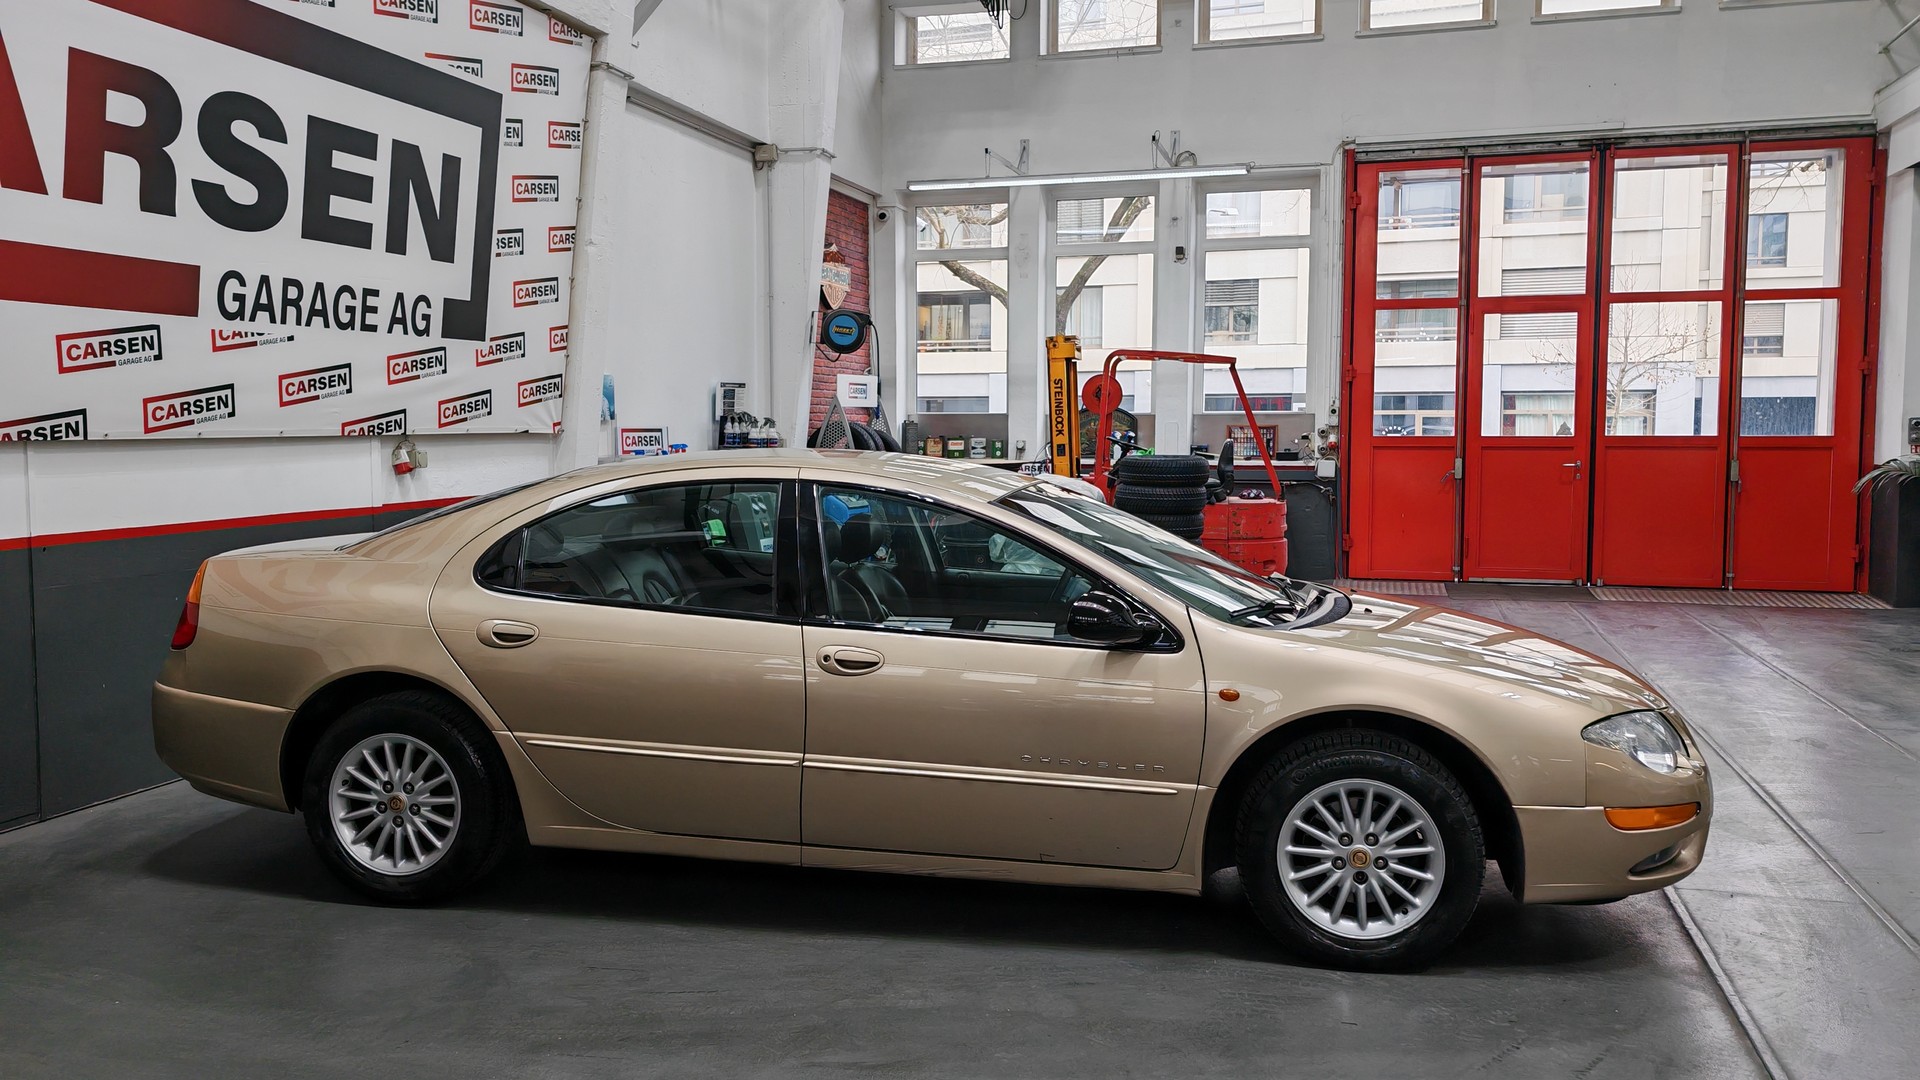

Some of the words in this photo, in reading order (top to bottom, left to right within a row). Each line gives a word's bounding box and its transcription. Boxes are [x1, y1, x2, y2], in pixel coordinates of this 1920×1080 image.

[474, 9, 520, 28] CARSEN
[515, 72, 556, 88] CARSEN
[504, 126, 520, 138] EN
[516, 183, 555, 194] CARSEN
[517, 284, 556, 300] CARSEN
[217, 270, 380, 332] GARAGE
[386, 292, 432, 337] AG
[66, 335, 154, 361] CARSEN
[259, 338, 278, 346] GARAGE
[480, 340, 522, 358] CARSEN
[118, 357, 142, 366] GARAGE
[392, 355, 443, 376] CARSEN
[285, 372, 347, 396] CARSEN
[522, 381, 560, 399] CARSEN
[321, 391, 338, 400] GARAGE
[151, 394, 229, 422] CARSEN
[443, 398, 488, 419] CARSEN
[1054, 378, 1064, 436] STEINBOCK
[196, 415, 218, 425] GARAGE
[625, 436, 660, 447] CARSEN
[1021, 754, 1164, 772] CHRYSLER
